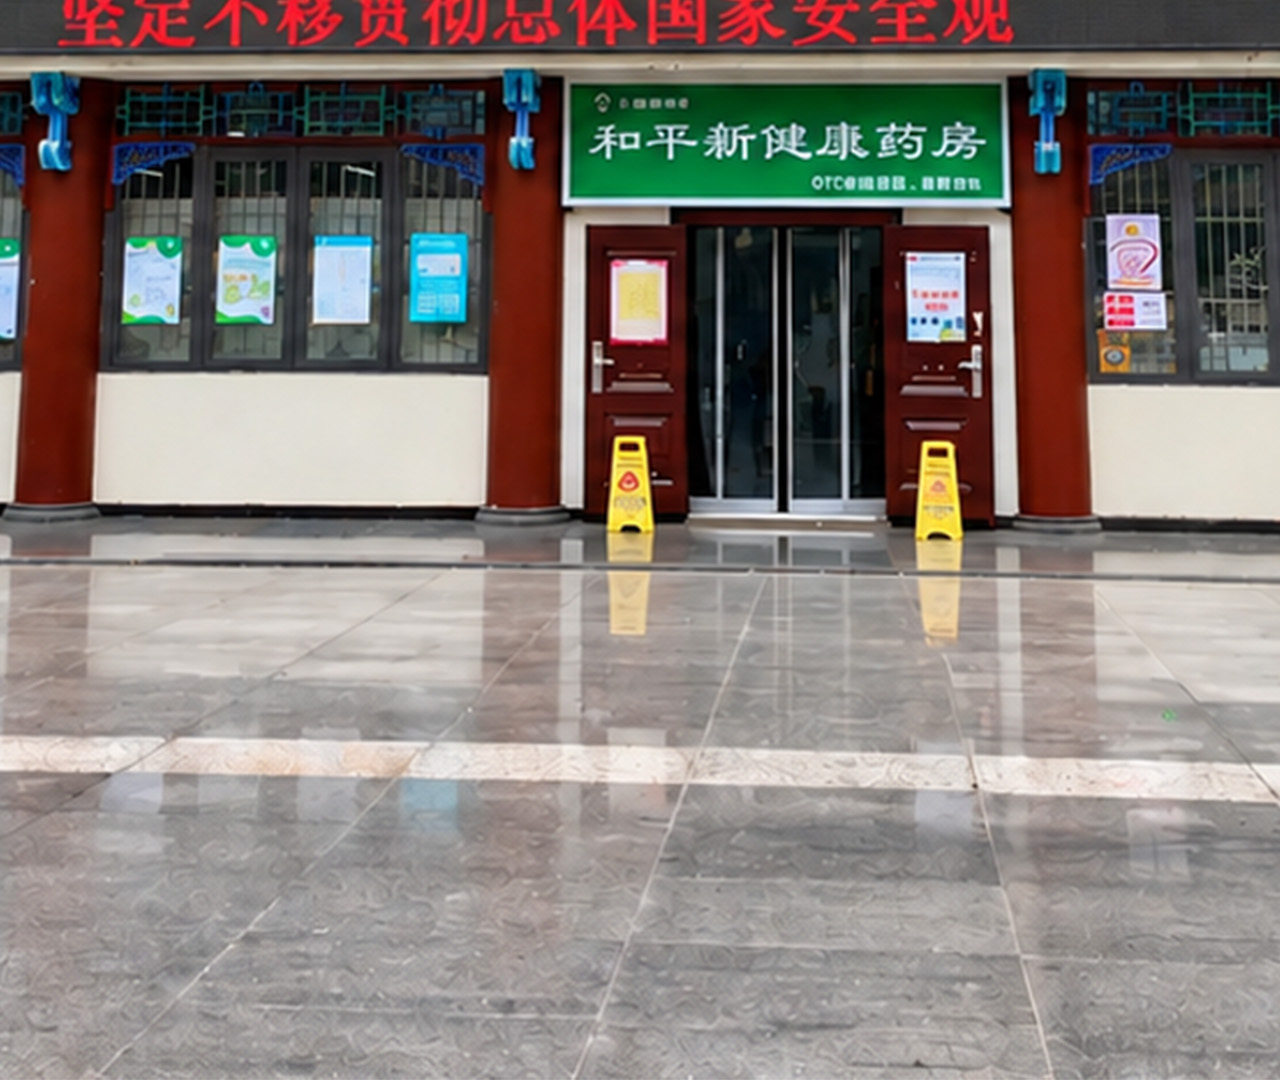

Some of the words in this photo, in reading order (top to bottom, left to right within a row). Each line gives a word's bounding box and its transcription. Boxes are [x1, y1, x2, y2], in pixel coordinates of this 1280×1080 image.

[589, 121, 987, 160] 和平新健康药房
